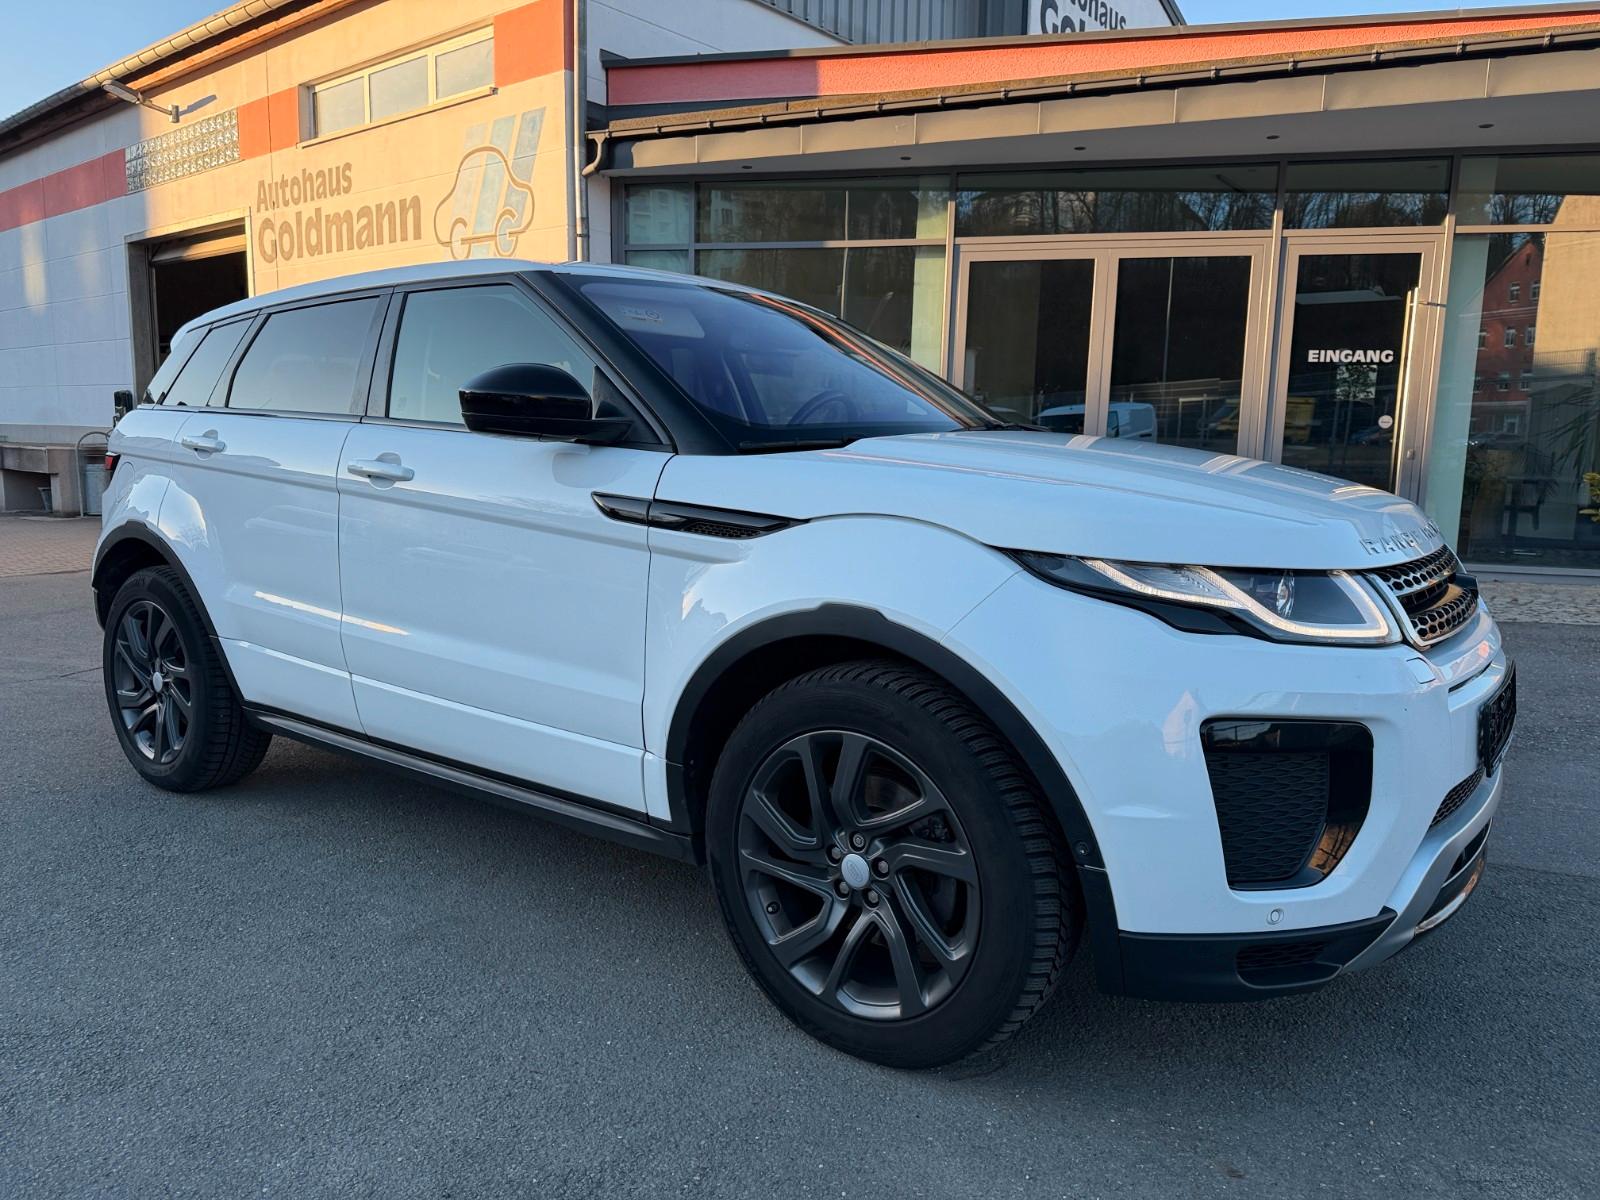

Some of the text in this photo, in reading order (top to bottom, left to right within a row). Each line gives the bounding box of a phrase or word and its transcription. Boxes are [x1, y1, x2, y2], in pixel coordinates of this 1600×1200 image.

[256, 162, 352, 213] Autohaus
[258, 195, 421, 263] Goldmann
[1308, 349, 1394, 363] EINGANG
